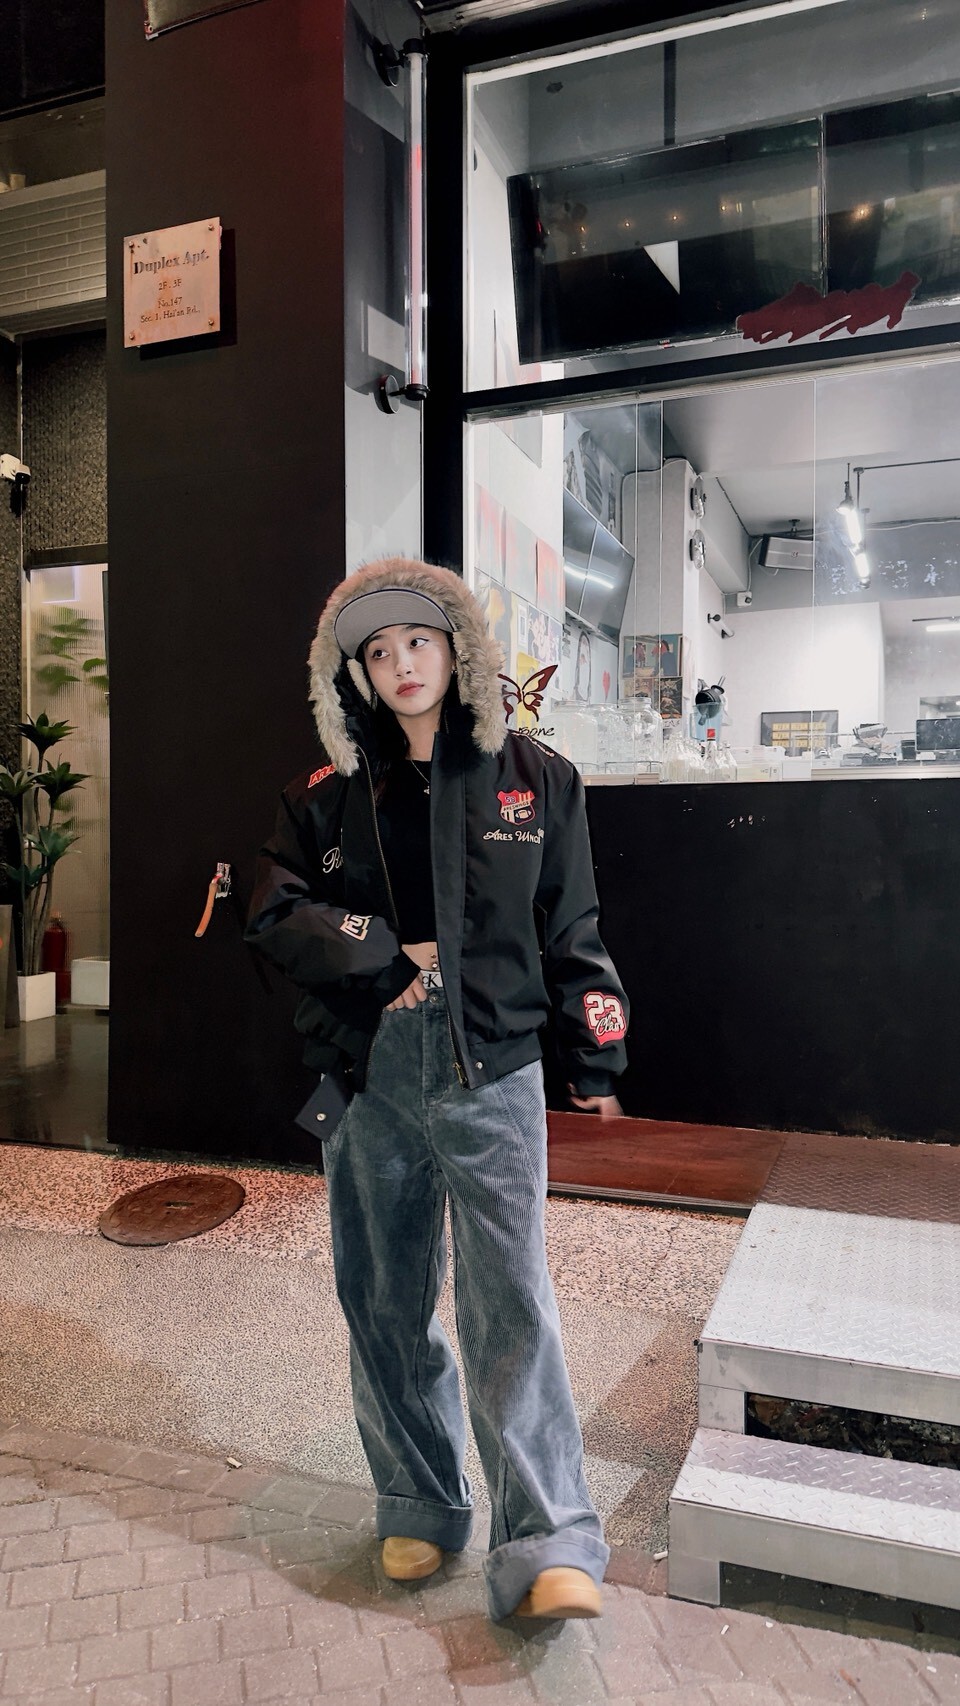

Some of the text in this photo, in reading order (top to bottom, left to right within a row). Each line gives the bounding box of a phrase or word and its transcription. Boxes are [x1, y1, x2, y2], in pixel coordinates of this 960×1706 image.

[134, 250, 210, 274] Duplex Apt.
[585, 993, 625, 1031] 23
